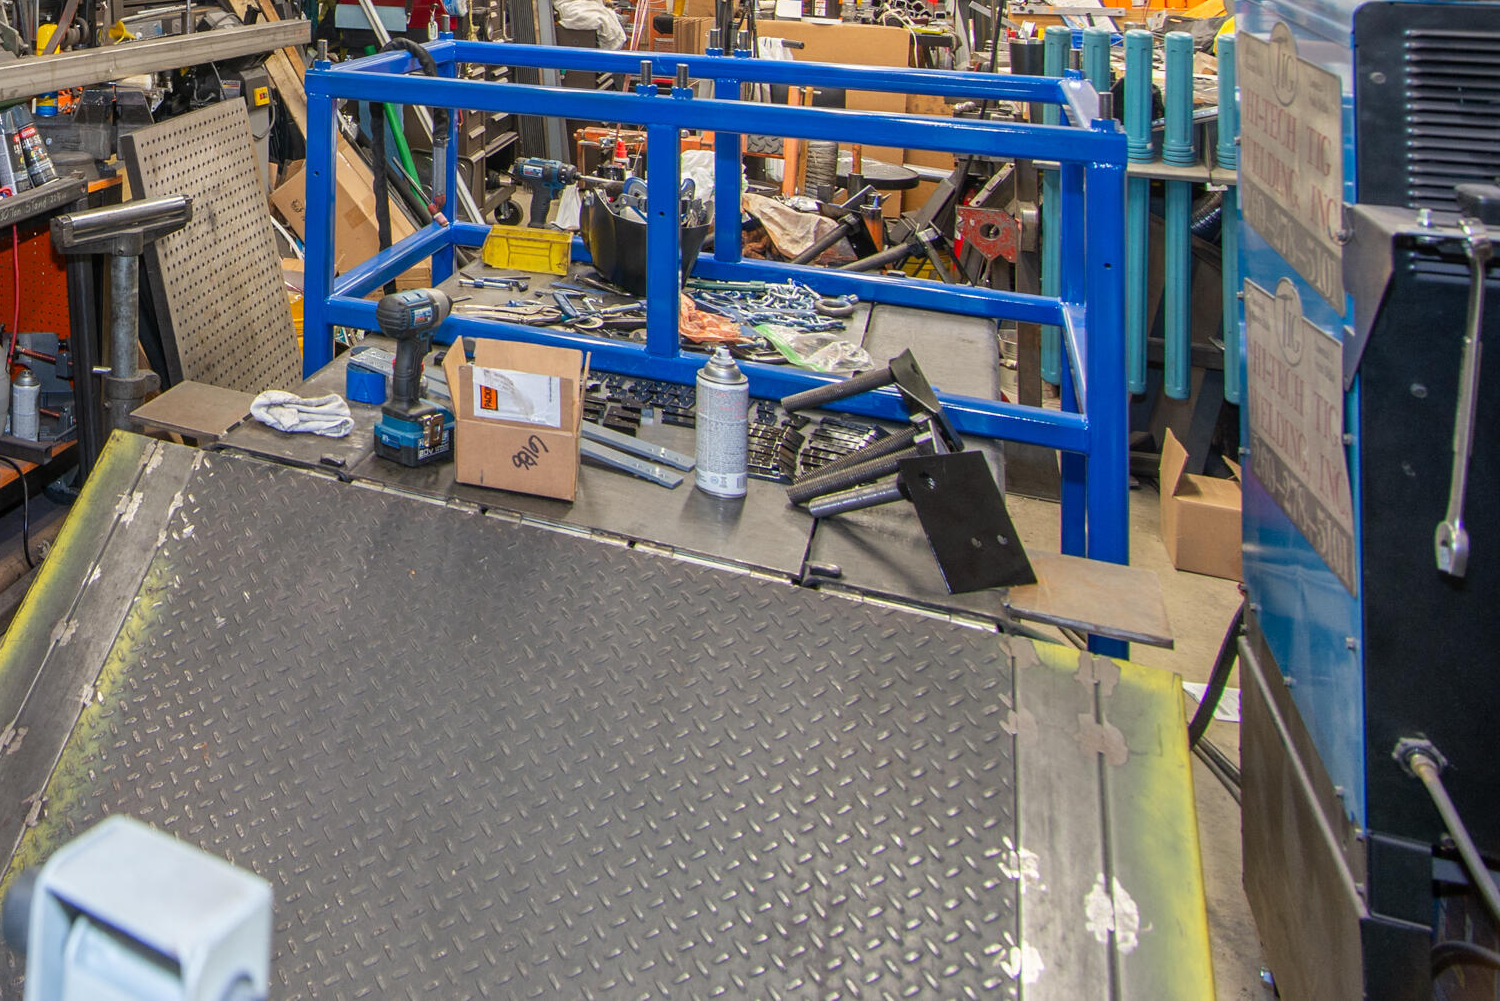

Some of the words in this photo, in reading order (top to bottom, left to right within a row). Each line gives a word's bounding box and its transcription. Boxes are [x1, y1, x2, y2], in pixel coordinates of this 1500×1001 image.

[1246, 89, 1296, 153] HI-TECH
[1306, 125, 1332, 177] TIG
[1252, 339, 1305, 417] HI-TECH
[1313, 391, 1340, 447] TIG
[1252, 436, 1350, 583] 269-278-5101
